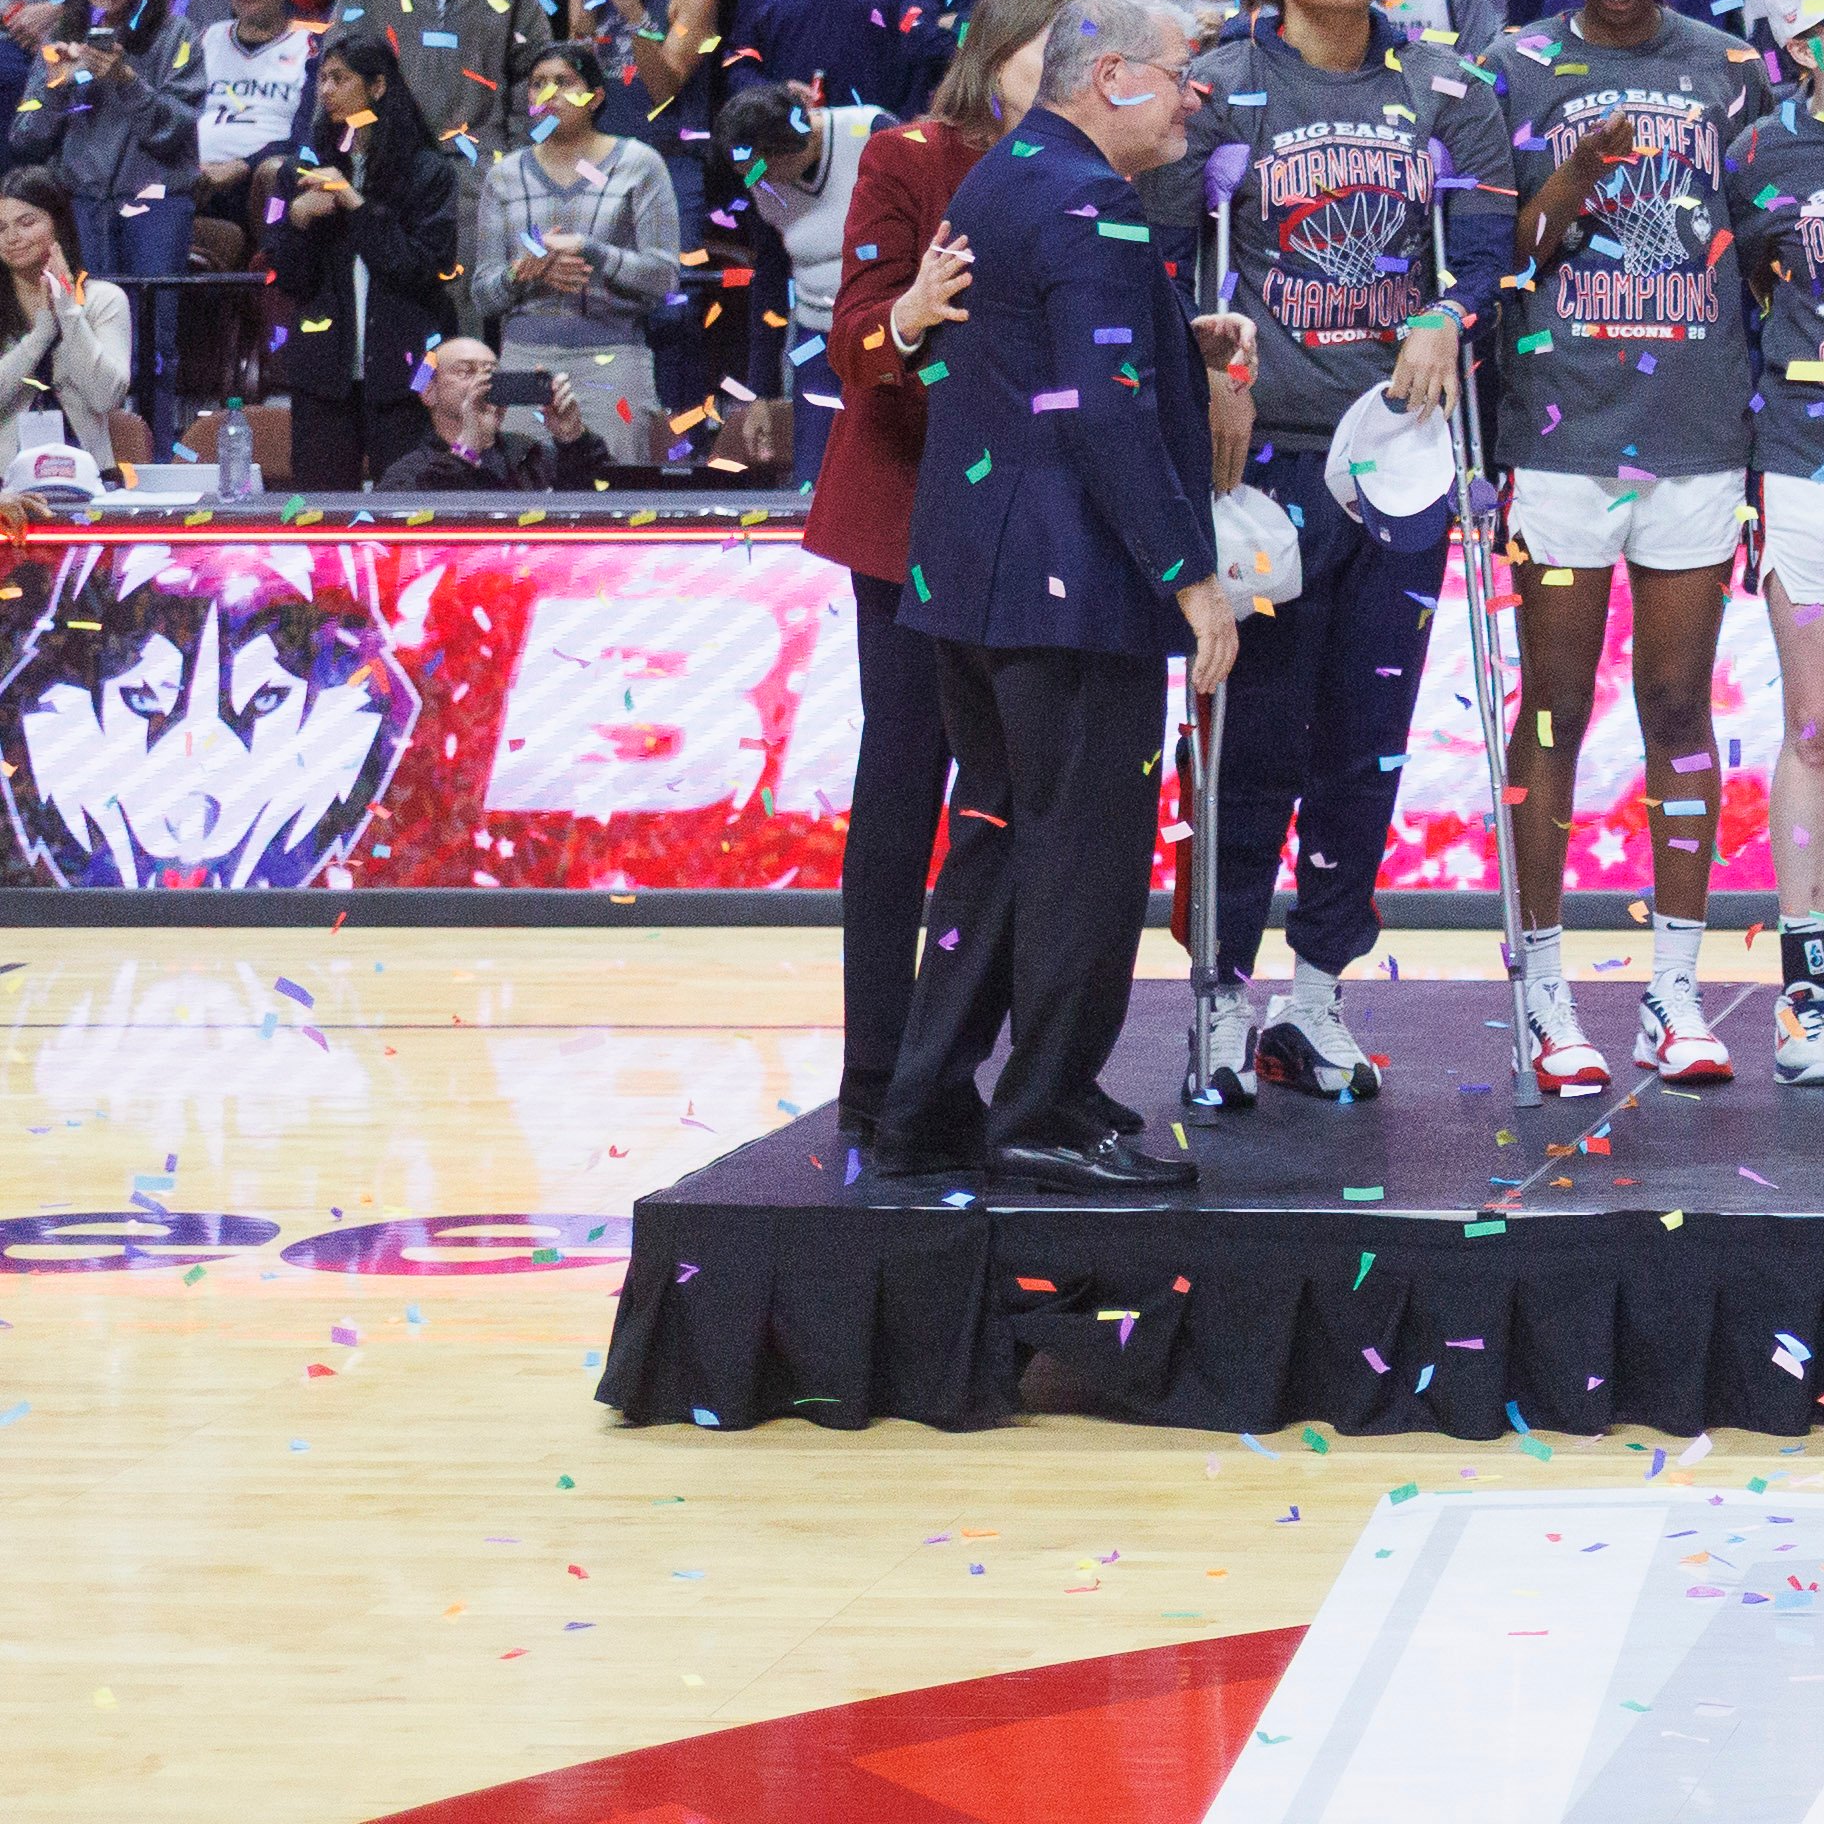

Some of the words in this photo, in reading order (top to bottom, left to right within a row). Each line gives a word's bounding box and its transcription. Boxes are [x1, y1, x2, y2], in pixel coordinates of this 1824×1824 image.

[1563, 90, 1619, 118] BIG
[1624, 91, 1708, 116] EAST
[1273, 122, 1330, 150] BIG
[1333, 122, 1417, 147] EAST
[1255, 147, 1435, 221] TOURNAMENT
[1263, 262, 1422, 328] CHAMPIONS
[1557, 264, 1719, 323] CHAMPIONS
[1318, 330, 1381, 345] UCONN
[1606, 326, 1674, 339] UCONN
[1688, 325, 1706, 340] 26
